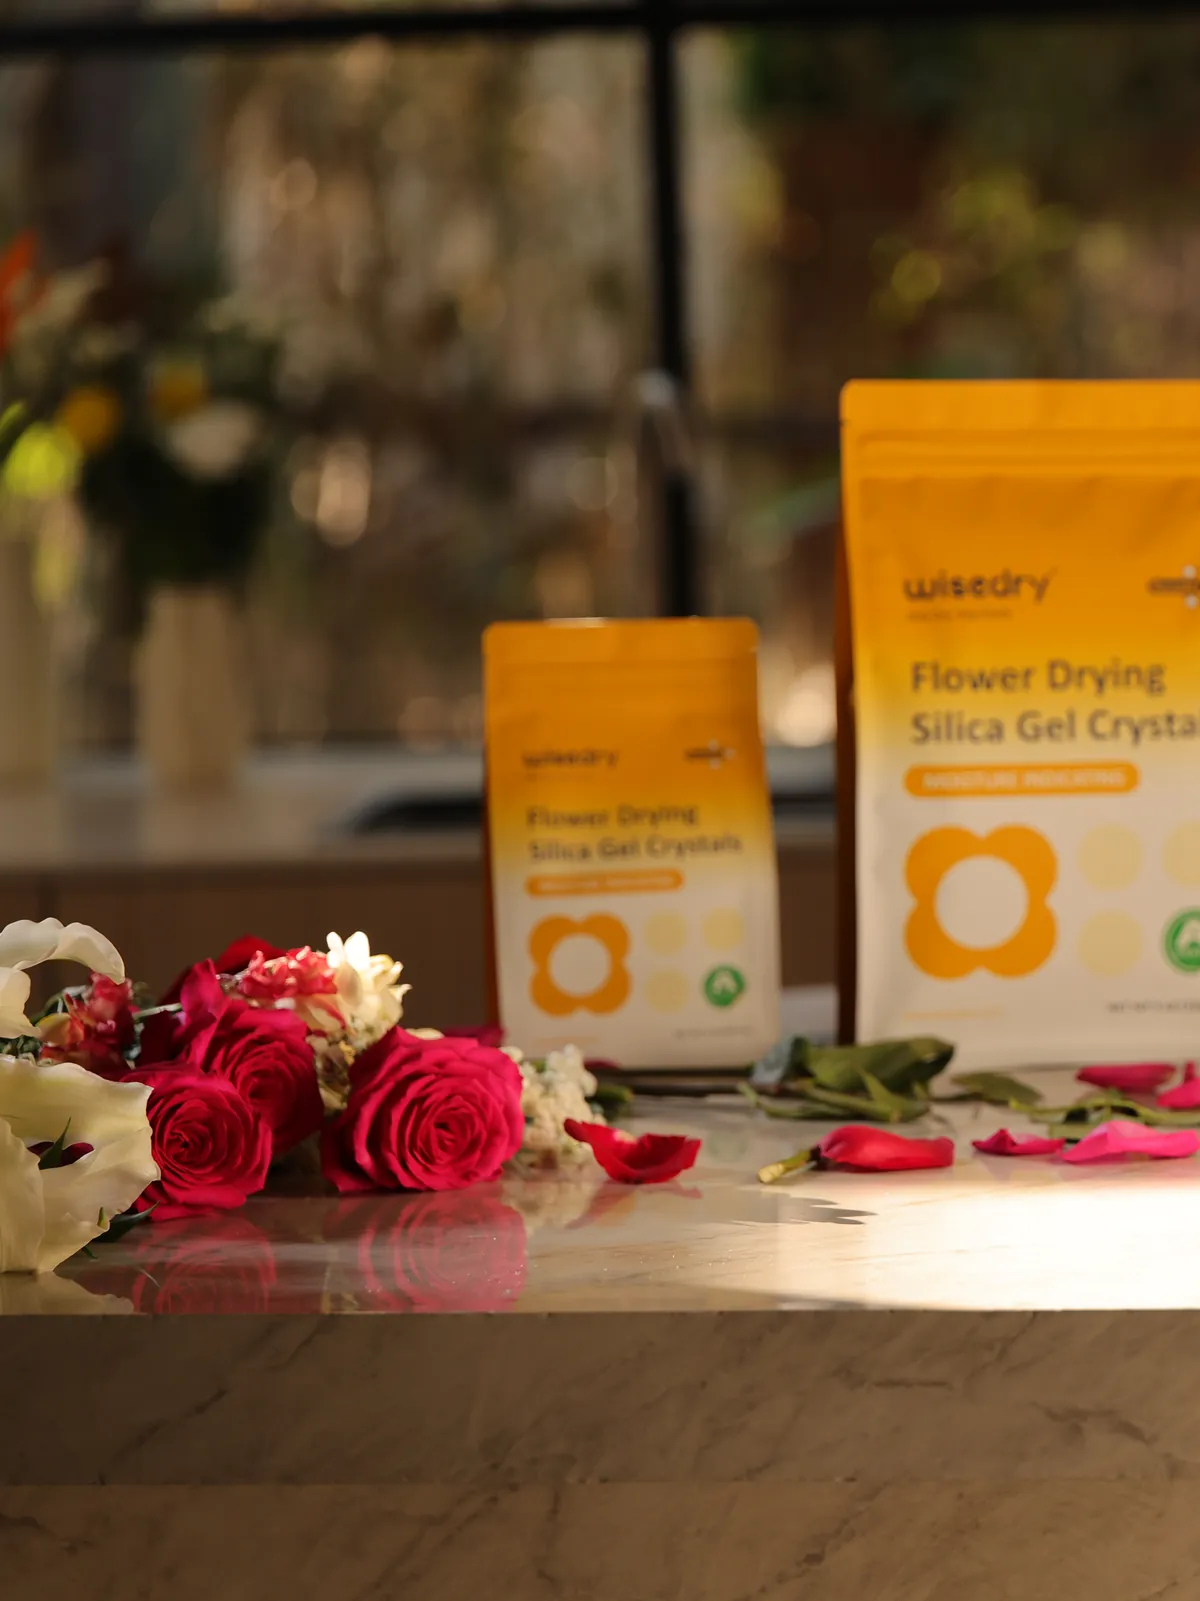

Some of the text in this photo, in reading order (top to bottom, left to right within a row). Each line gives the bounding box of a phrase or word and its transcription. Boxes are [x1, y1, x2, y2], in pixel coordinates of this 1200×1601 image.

[911, 655, 1165, 696] Flower Drying
[911, 711, 1005, 745] Silica
[1017, 708, 1077, 743] Gel
